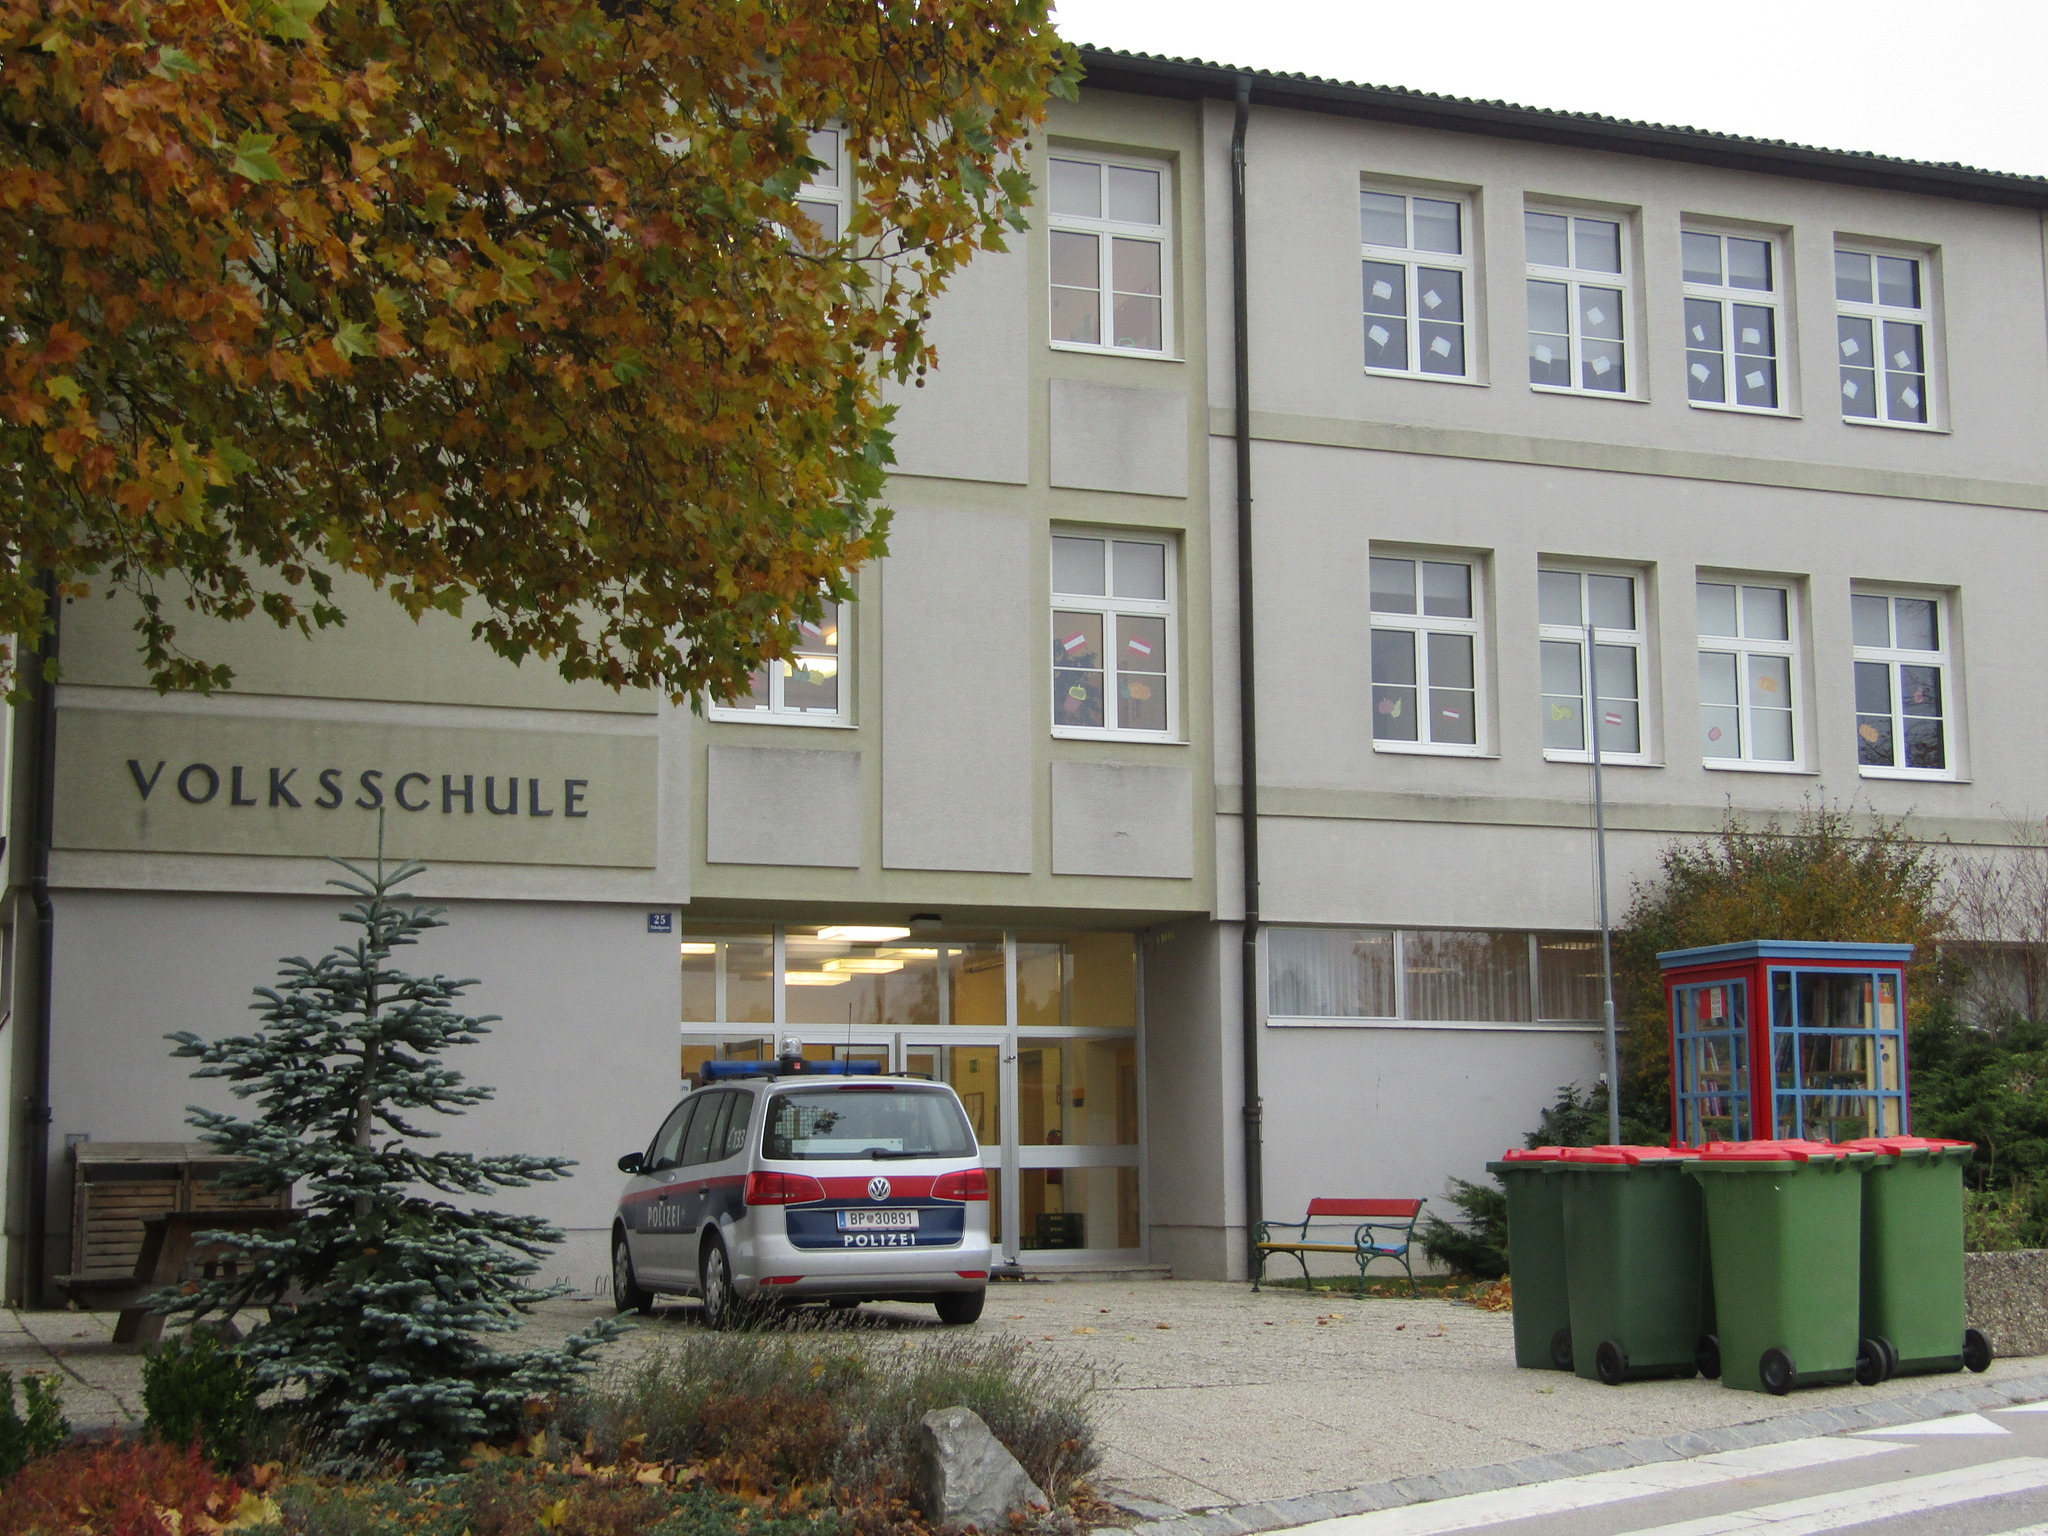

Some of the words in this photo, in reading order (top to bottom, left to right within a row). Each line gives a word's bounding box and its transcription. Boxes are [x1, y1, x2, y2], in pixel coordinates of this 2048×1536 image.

[127, 759, 589, 817] VOLKSSCHULE
[654, 914, 666, 925] 25
[733, 1129, 745, 1149] 133
[647, 1205, 680, 1228] POLIZEI
[850, 1212, 866, 1225] BP
[875, 1212, 912, 1225] 30891
[844, 1233, 916, 1247] POLIZEI
